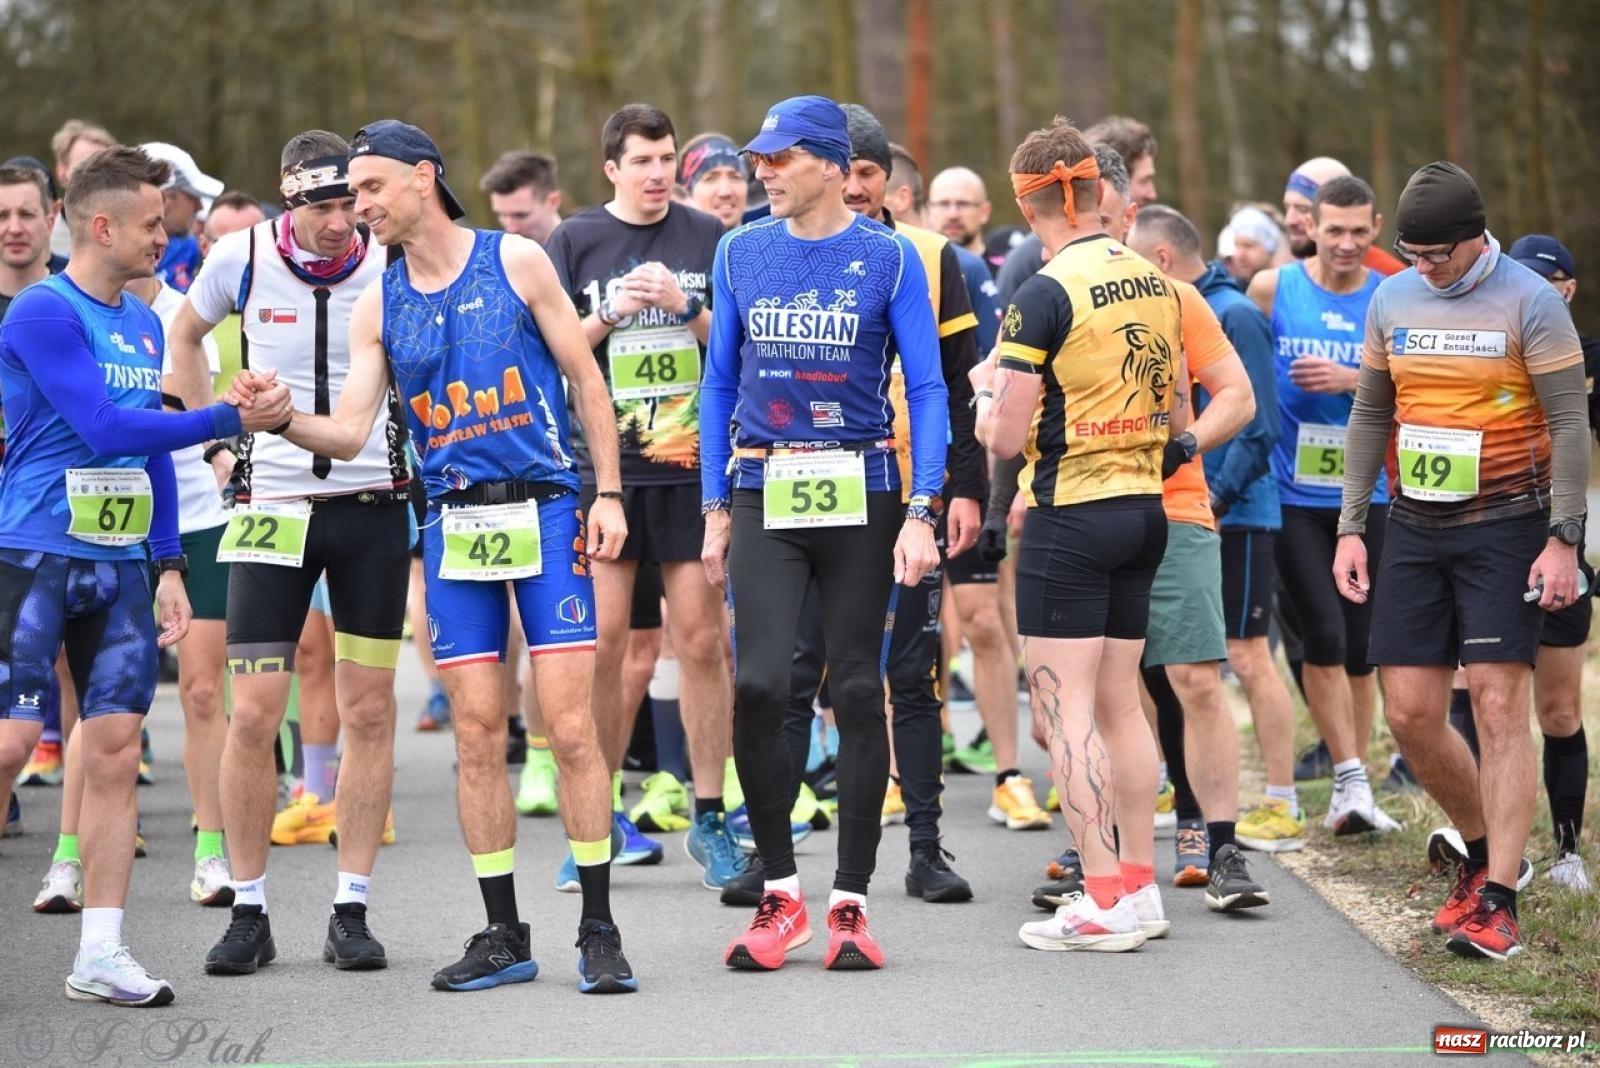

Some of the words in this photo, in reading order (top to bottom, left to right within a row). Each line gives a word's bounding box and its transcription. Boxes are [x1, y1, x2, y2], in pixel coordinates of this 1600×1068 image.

[638, 306, 682, 327] RAFA
[751, 311, 856, 343] SILESIAN
[756, 342, 815, 360] TRIATHLON
[820, 345, 851, 362] TEAM
[1278, 336, 1363, 365] RUNNE
[1406, 333, 1438, 350] SCI
[1443, 342, 1499, 353] Entuzjaści
[97, 362, 162, 393] UNNE
[635, 353, 677, 384] 48
[794, 368, 848, 384] handlobud
[1318, 449, 1345, 475] 5
[1411, 454, 1452, 488] 49
[791, 479, 838, 514] 53
[98, 497, 135, 531] 67
[236, 516, 279, 550] 22
[468, 532, 513, 567] 42
